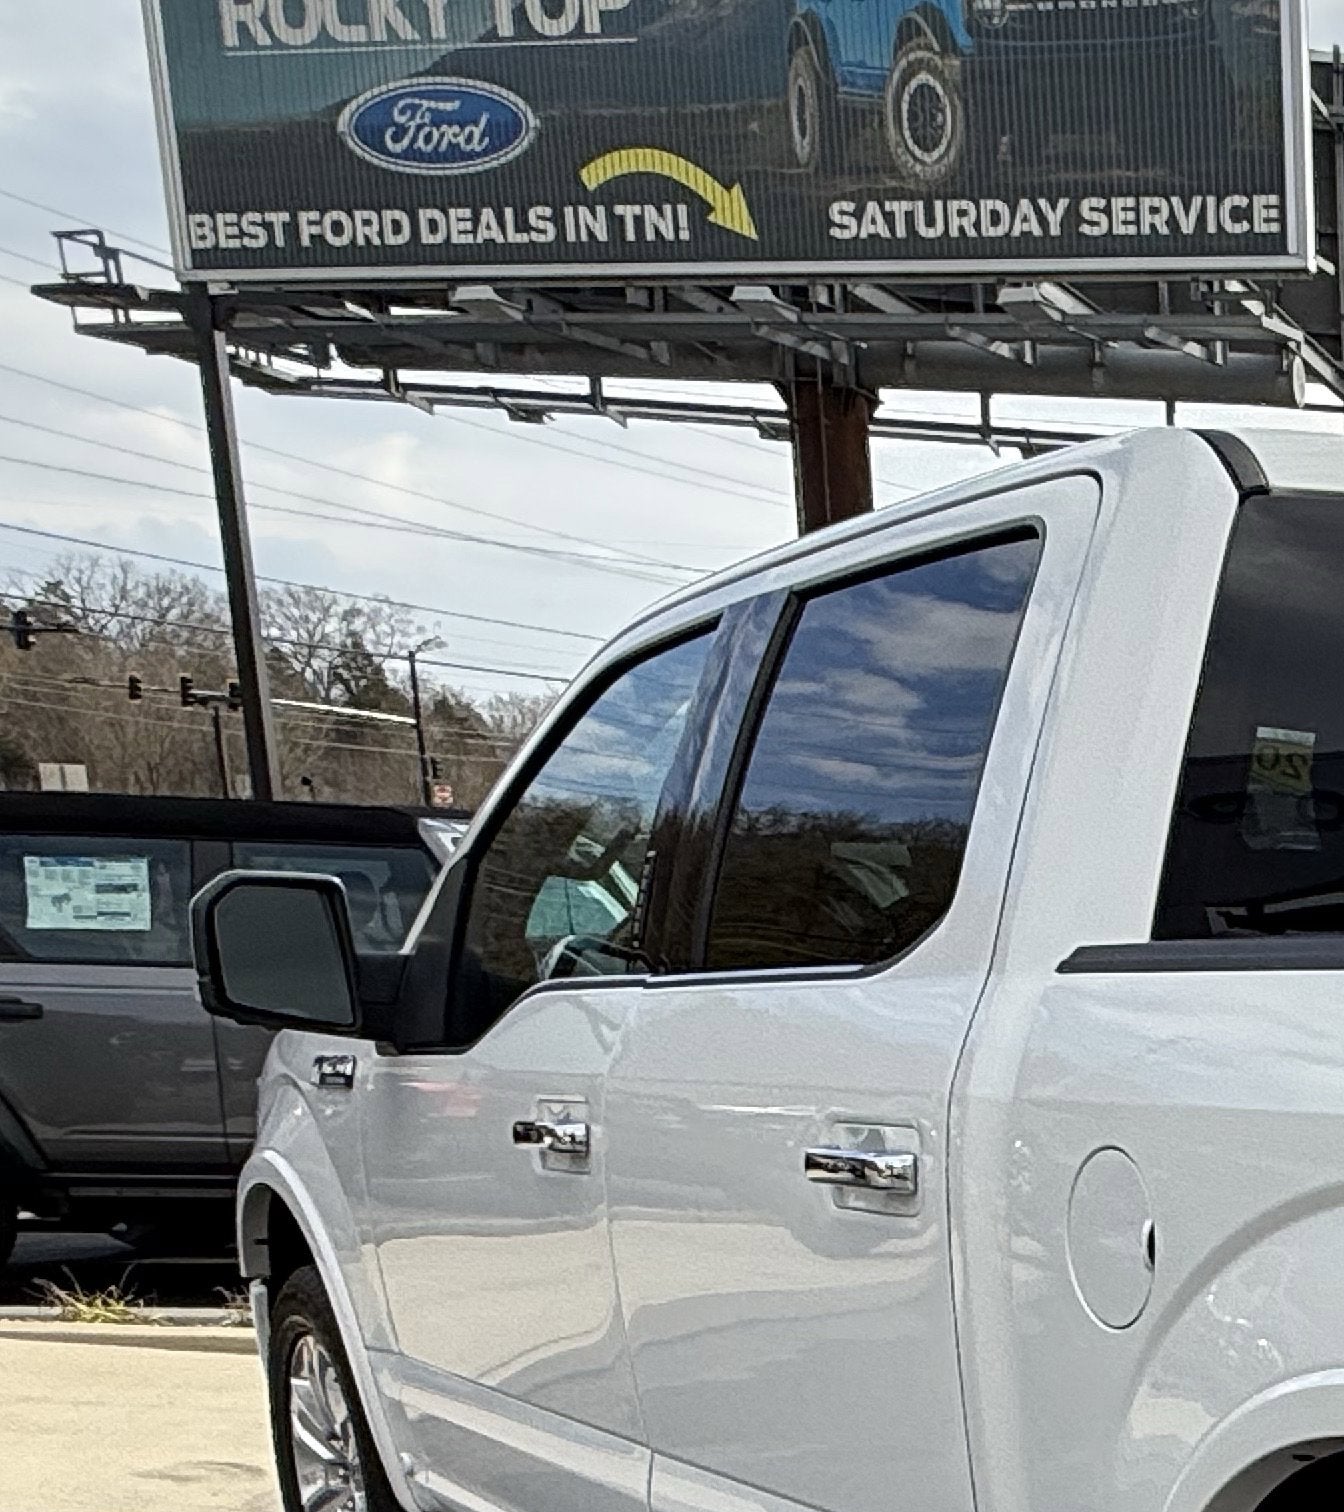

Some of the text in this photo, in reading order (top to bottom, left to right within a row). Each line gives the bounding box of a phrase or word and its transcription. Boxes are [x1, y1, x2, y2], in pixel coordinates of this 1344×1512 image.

[222, 0, 448, 47] ROCKY
[384, 97, 490, 154] Ford
[188, 203, 691, 250] BEST FORD DEALS IN TN!
[828, 194, 1282, 240] SATURDAY SERVICE
